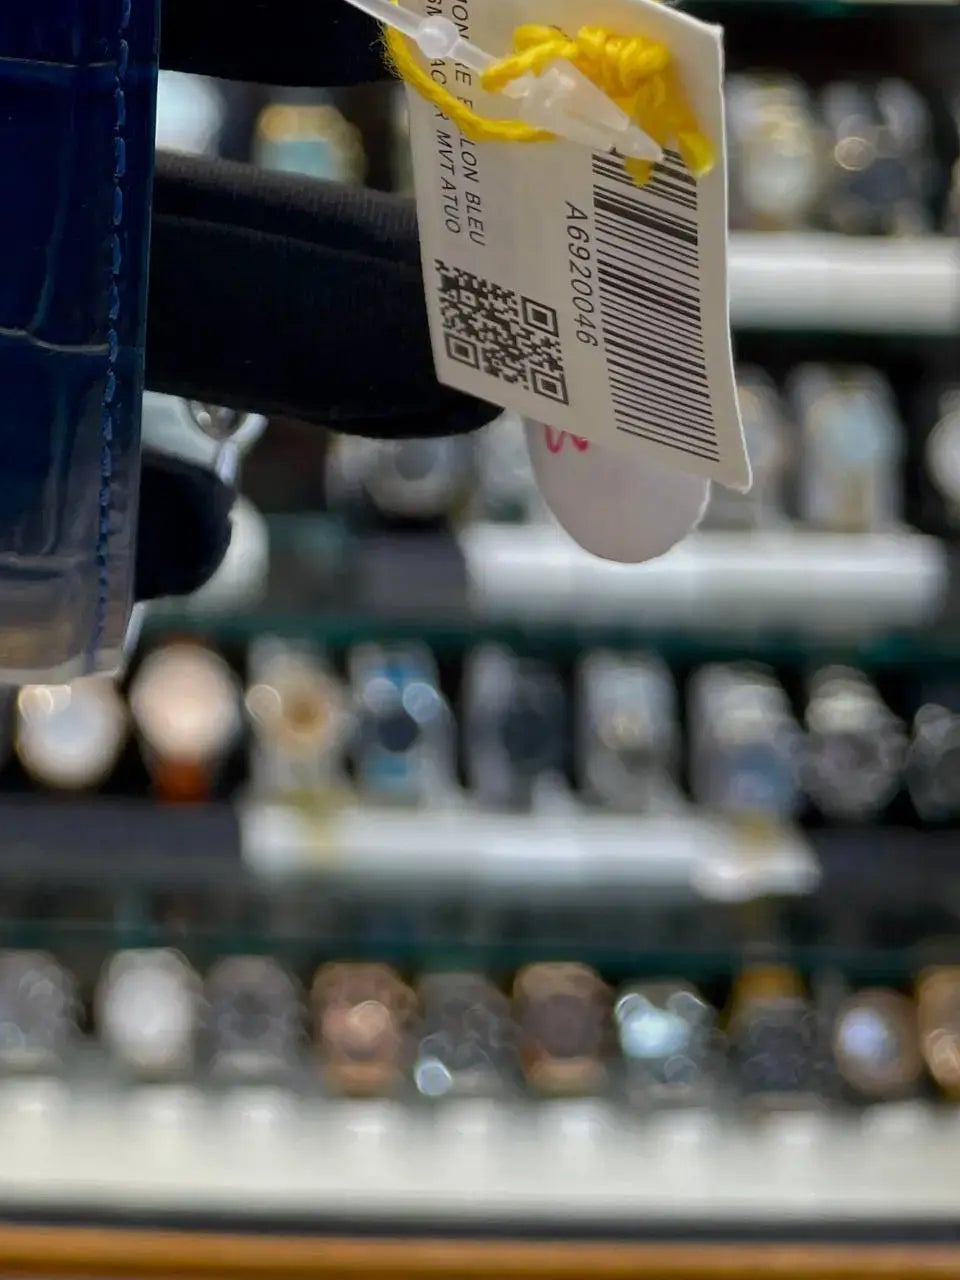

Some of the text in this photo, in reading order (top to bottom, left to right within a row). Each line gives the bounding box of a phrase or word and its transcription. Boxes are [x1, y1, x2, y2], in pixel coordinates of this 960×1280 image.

[436, 129, 455, 177] MVT
[440, 179, 461, 234] ATUO
[464, 192, 486, 247] BLEU
[564, 200, 598, 348] A6920046
